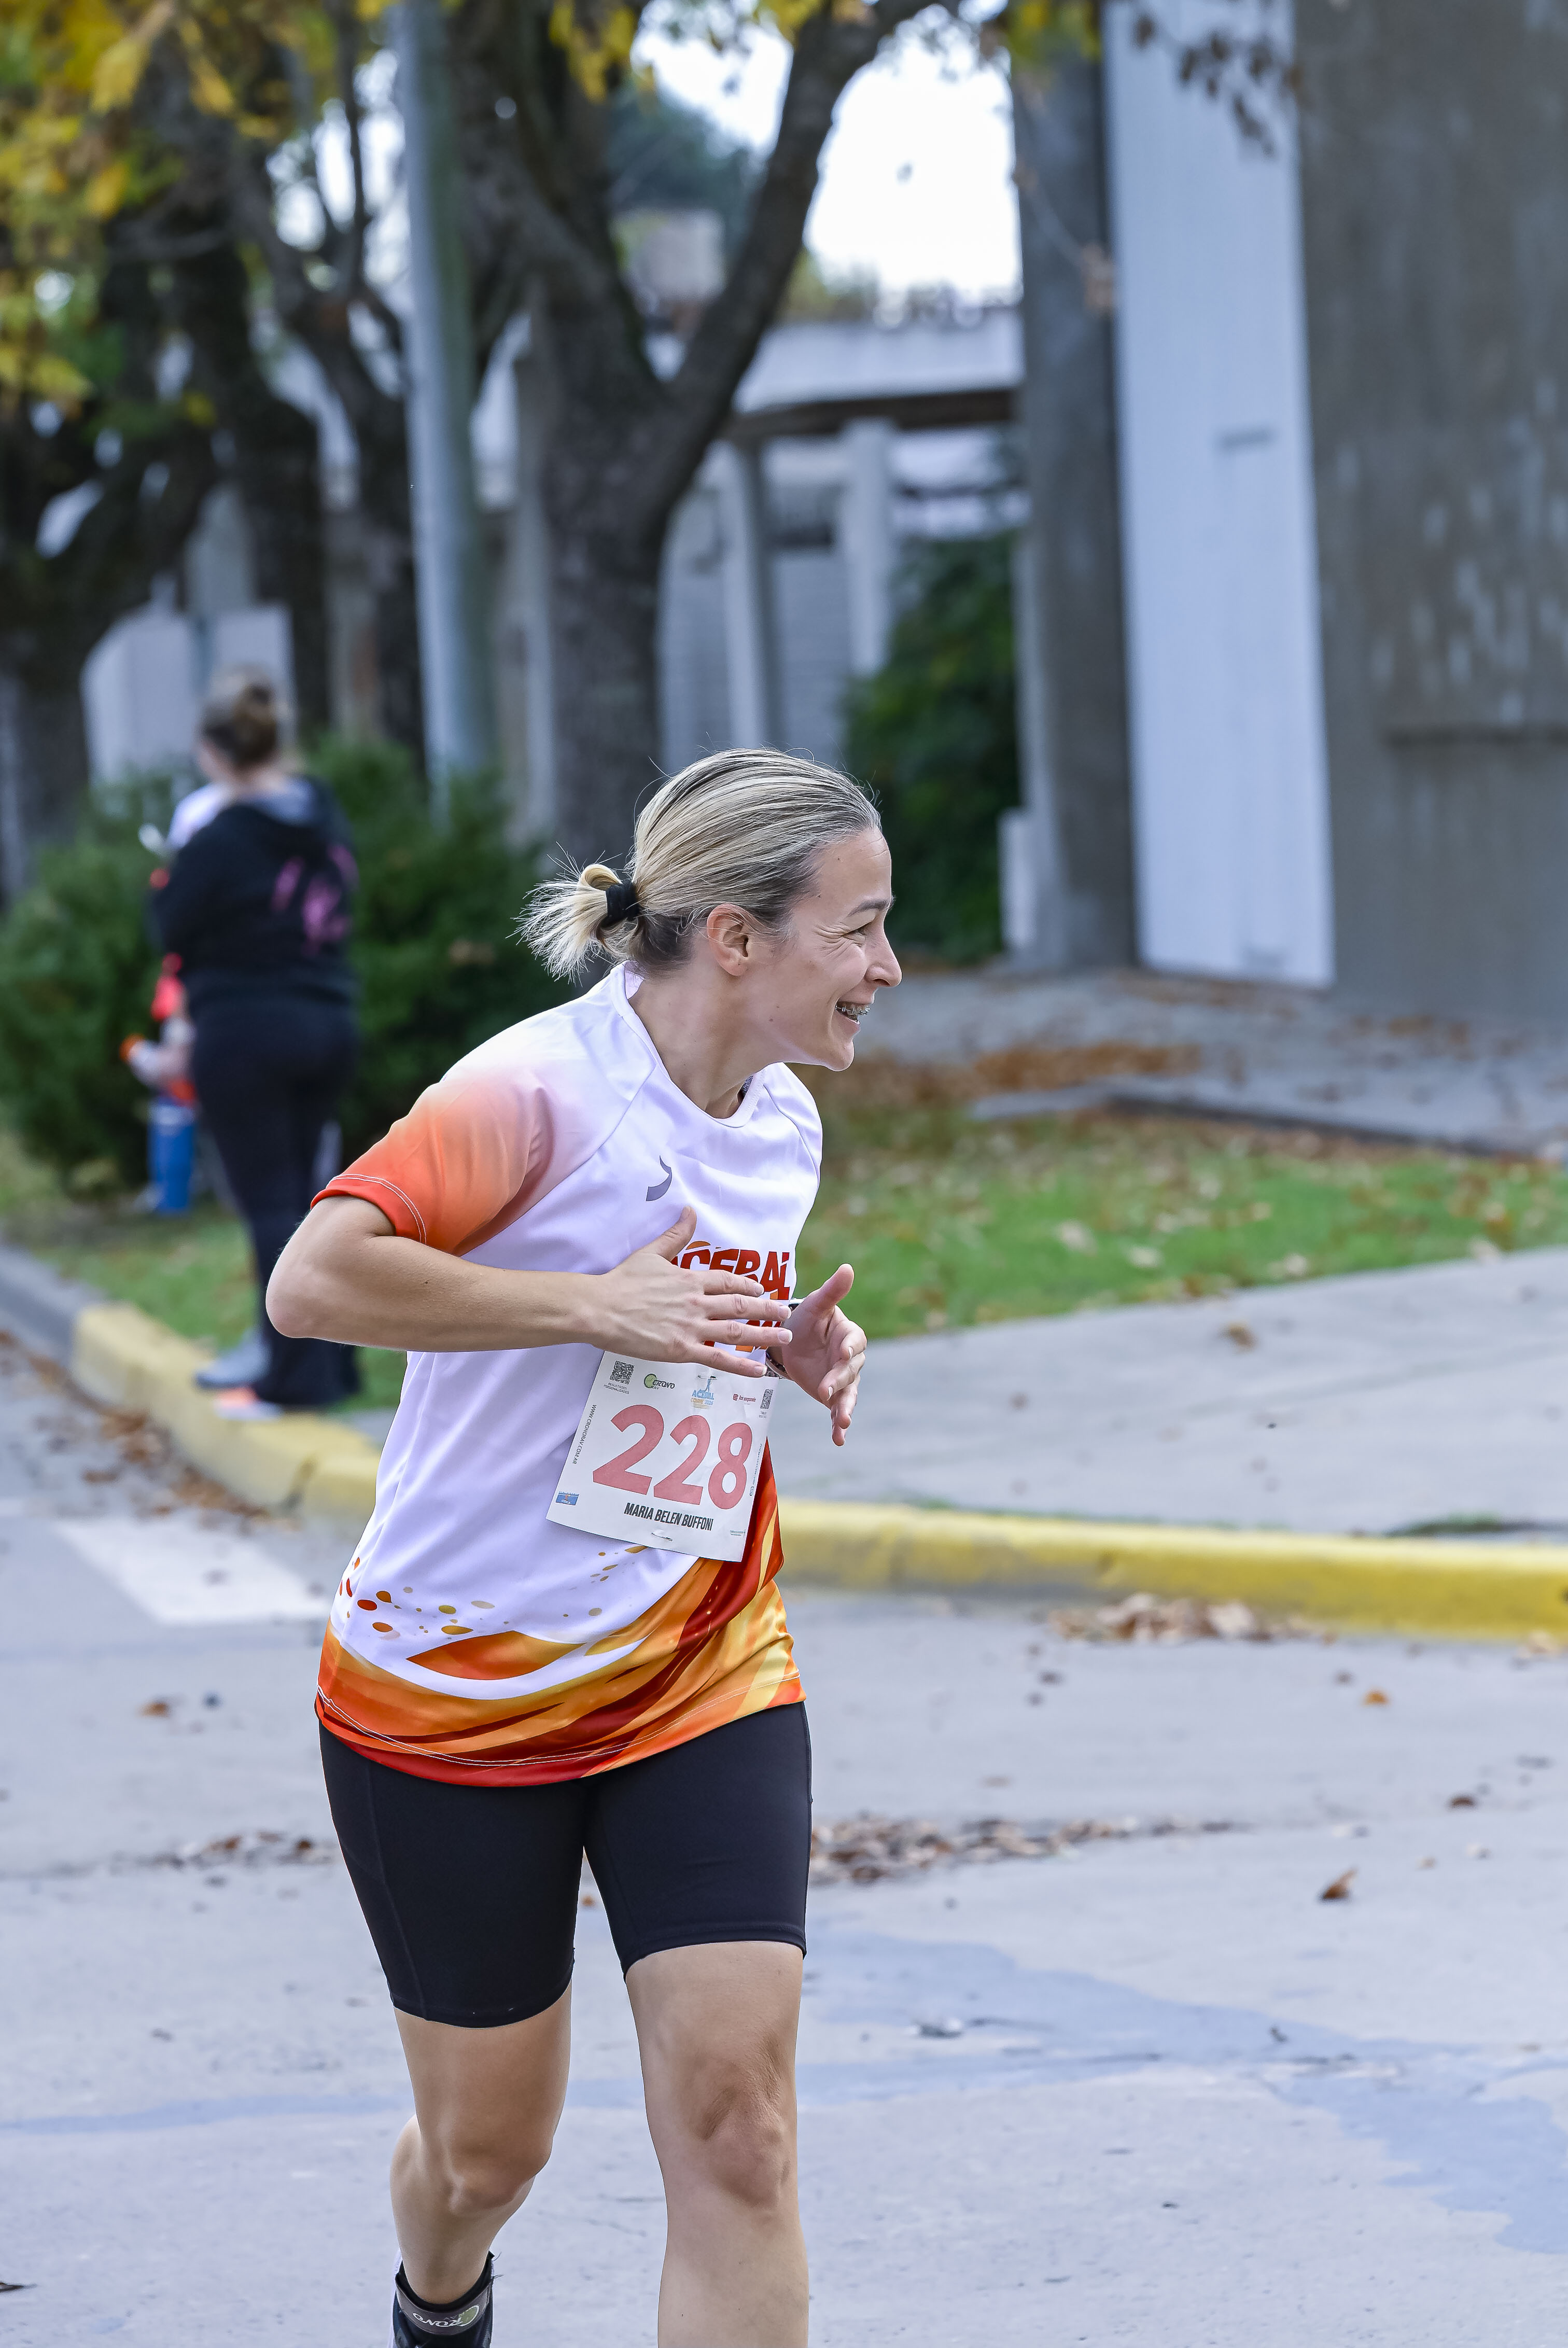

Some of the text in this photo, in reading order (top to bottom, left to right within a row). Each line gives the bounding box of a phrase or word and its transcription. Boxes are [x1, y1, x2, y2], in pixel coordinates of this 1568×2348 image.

[670, 1248, 790, 1301] EBAL
[593, 1404, 753, 1510] 228
[623, 1502, 714, 1531] MARIA BELEN BUFFONI
